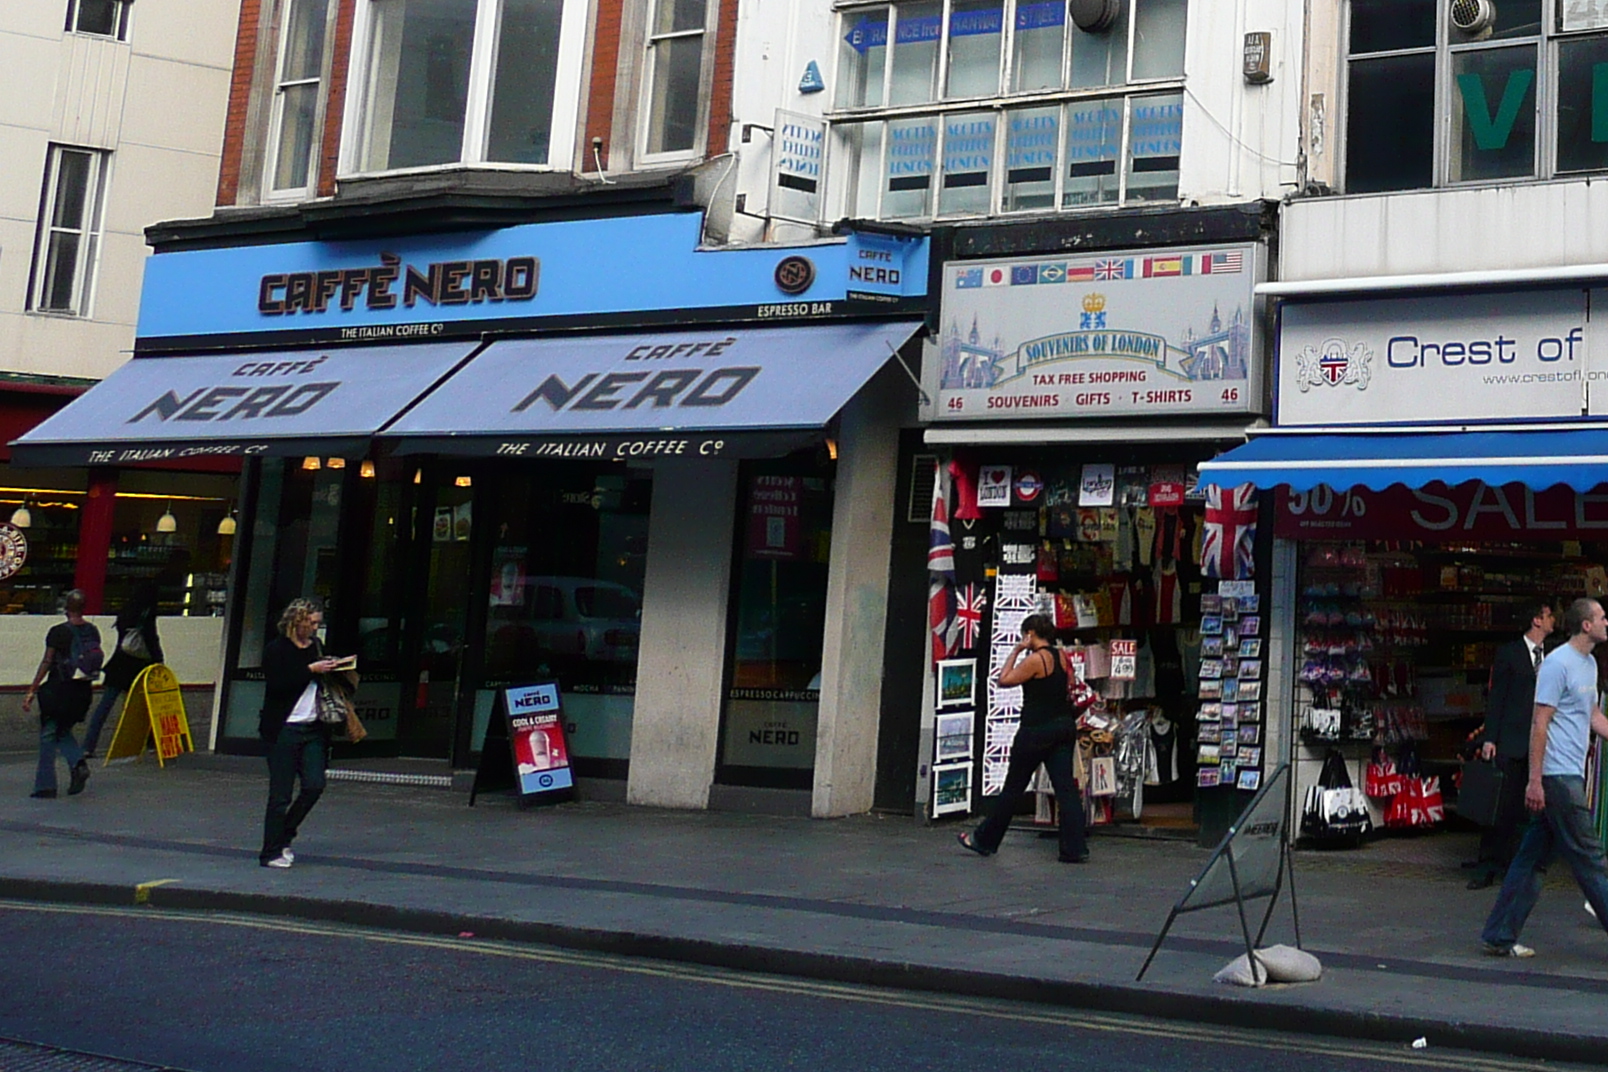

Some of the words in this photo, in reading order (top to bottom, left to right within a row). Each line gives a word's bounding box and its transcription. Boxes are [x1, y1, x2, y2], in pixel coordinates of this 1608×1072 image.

[258, 251, 401, 315] CAFFÈ
[403, 256, 540, 308] NERO
[849, 266, 900, 285] NERO
[757, 303, 808, 318] ESPRESSO
[810, 302, 832, 316] BAR
[341, 327, 357, 339] THE
[358, 325, 394, 338] ITALIAN
[395, 324, 430, 336] COFFEE
[1026, 334, 1090, 361] SOUVENIRS
[1093, 333, 1108, 352] OF
[1111, 333, 1161, 358] LONDON
[1387, 334, 1516, 368] Crest
[1537, 327, 1583, 362] of
[1032, 374, 1055, 385] TAX
[1058, 373, 1086, 385] FREE
[1089, 371, 1147, 384] SHOPPING
[509, 366, 762, 413] NERO
[125, 381, 343, 424] NERO
[947, 397, 964, 410] 46
[987, 394, 1059, 409] SOUVENIRS
[1075, 392, 1111, 406] GIFTS
[1131, 389, 1192, 404] T-SHIRTS
[1221, 388, 1239, 401] 46
[88, 449, 112, 464] THE
[119, 447, 174, 463] ITALIAN
[496, 443, 530, 455] THE
[538, 442, 605, 457] ITALIAN
[616, 441, 688, 457] COFFEE
[1111, 642, 1136, 656] SALE
[514, 695, 551, 708] NERO
[729, 688, 772, 699] ESPRESSO
[773, 689, 820, 700] CAPPUCCIN
[356, 707, 391, 721] ERO
[512, 718, 529, 728] COOL
[749, 730, 799, 745] NERO
